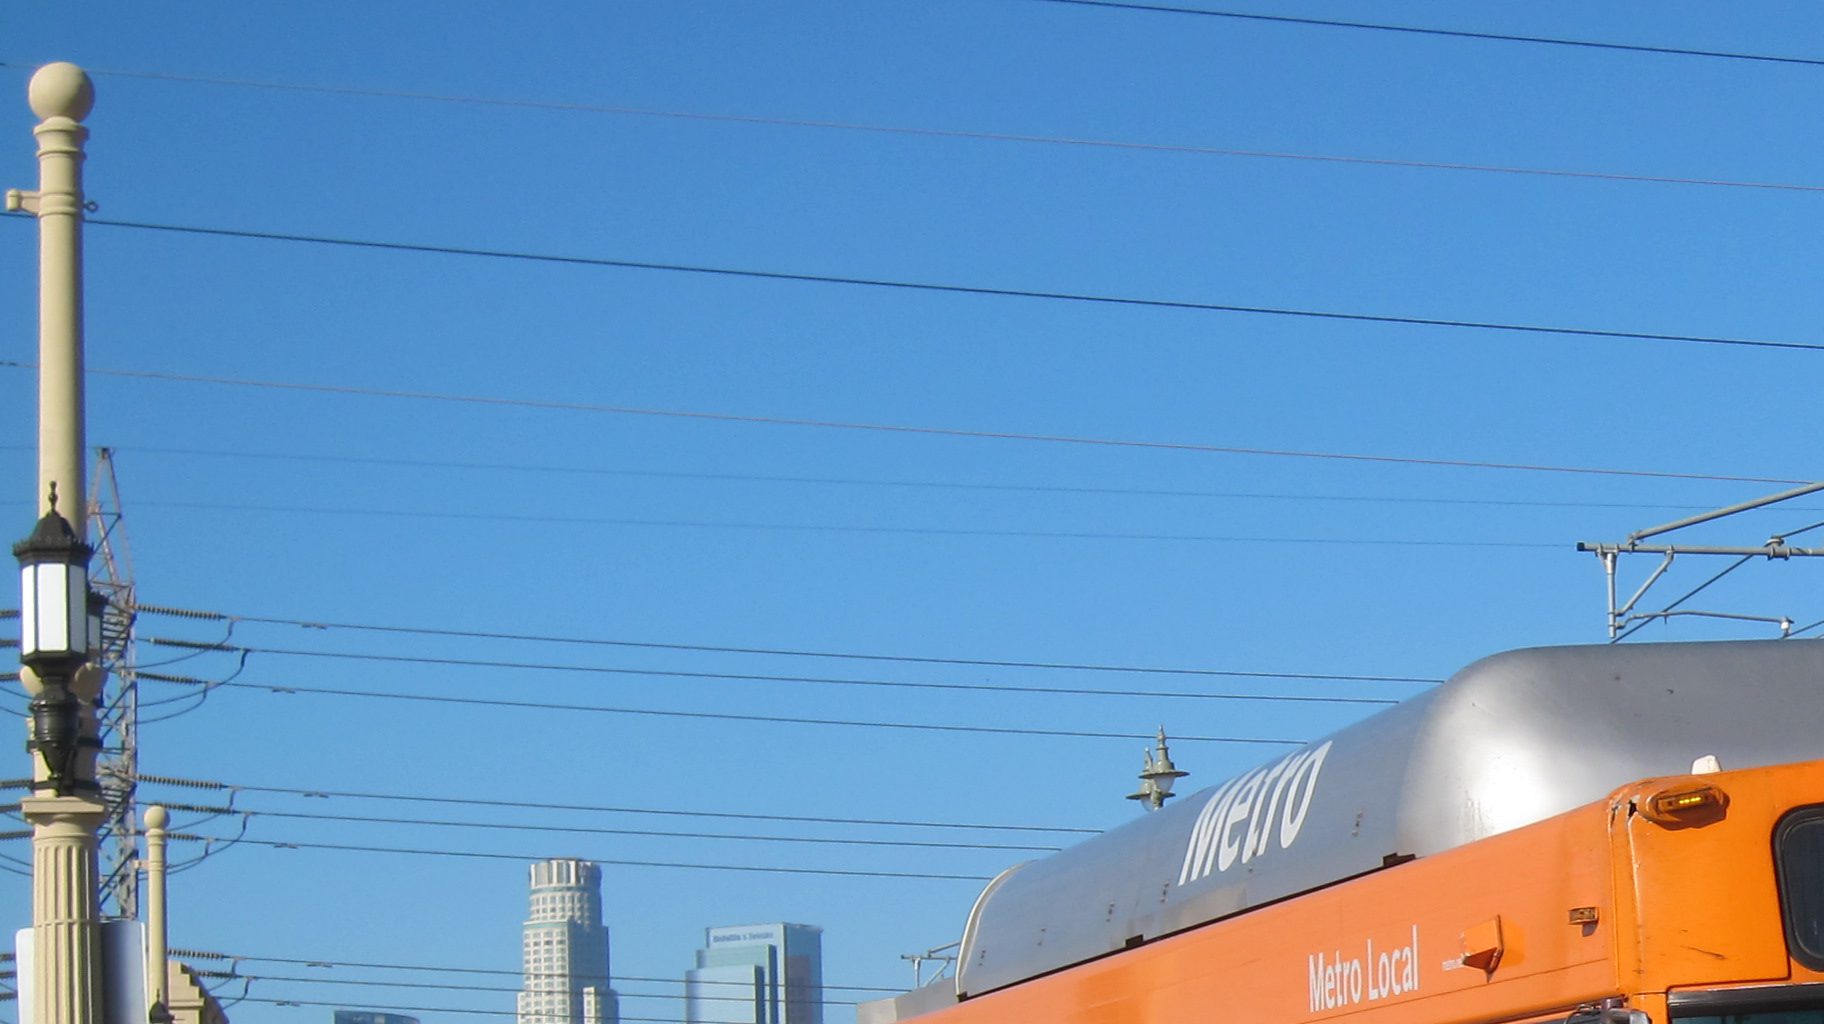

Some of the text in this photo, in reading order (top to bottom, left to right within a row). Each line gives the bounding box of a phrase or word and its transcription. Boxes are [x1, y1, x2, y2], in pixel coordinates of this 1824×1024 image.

[1177, 740, 1333, 887] Metro
[1308, 924, 1420, 1013] Metro Local
